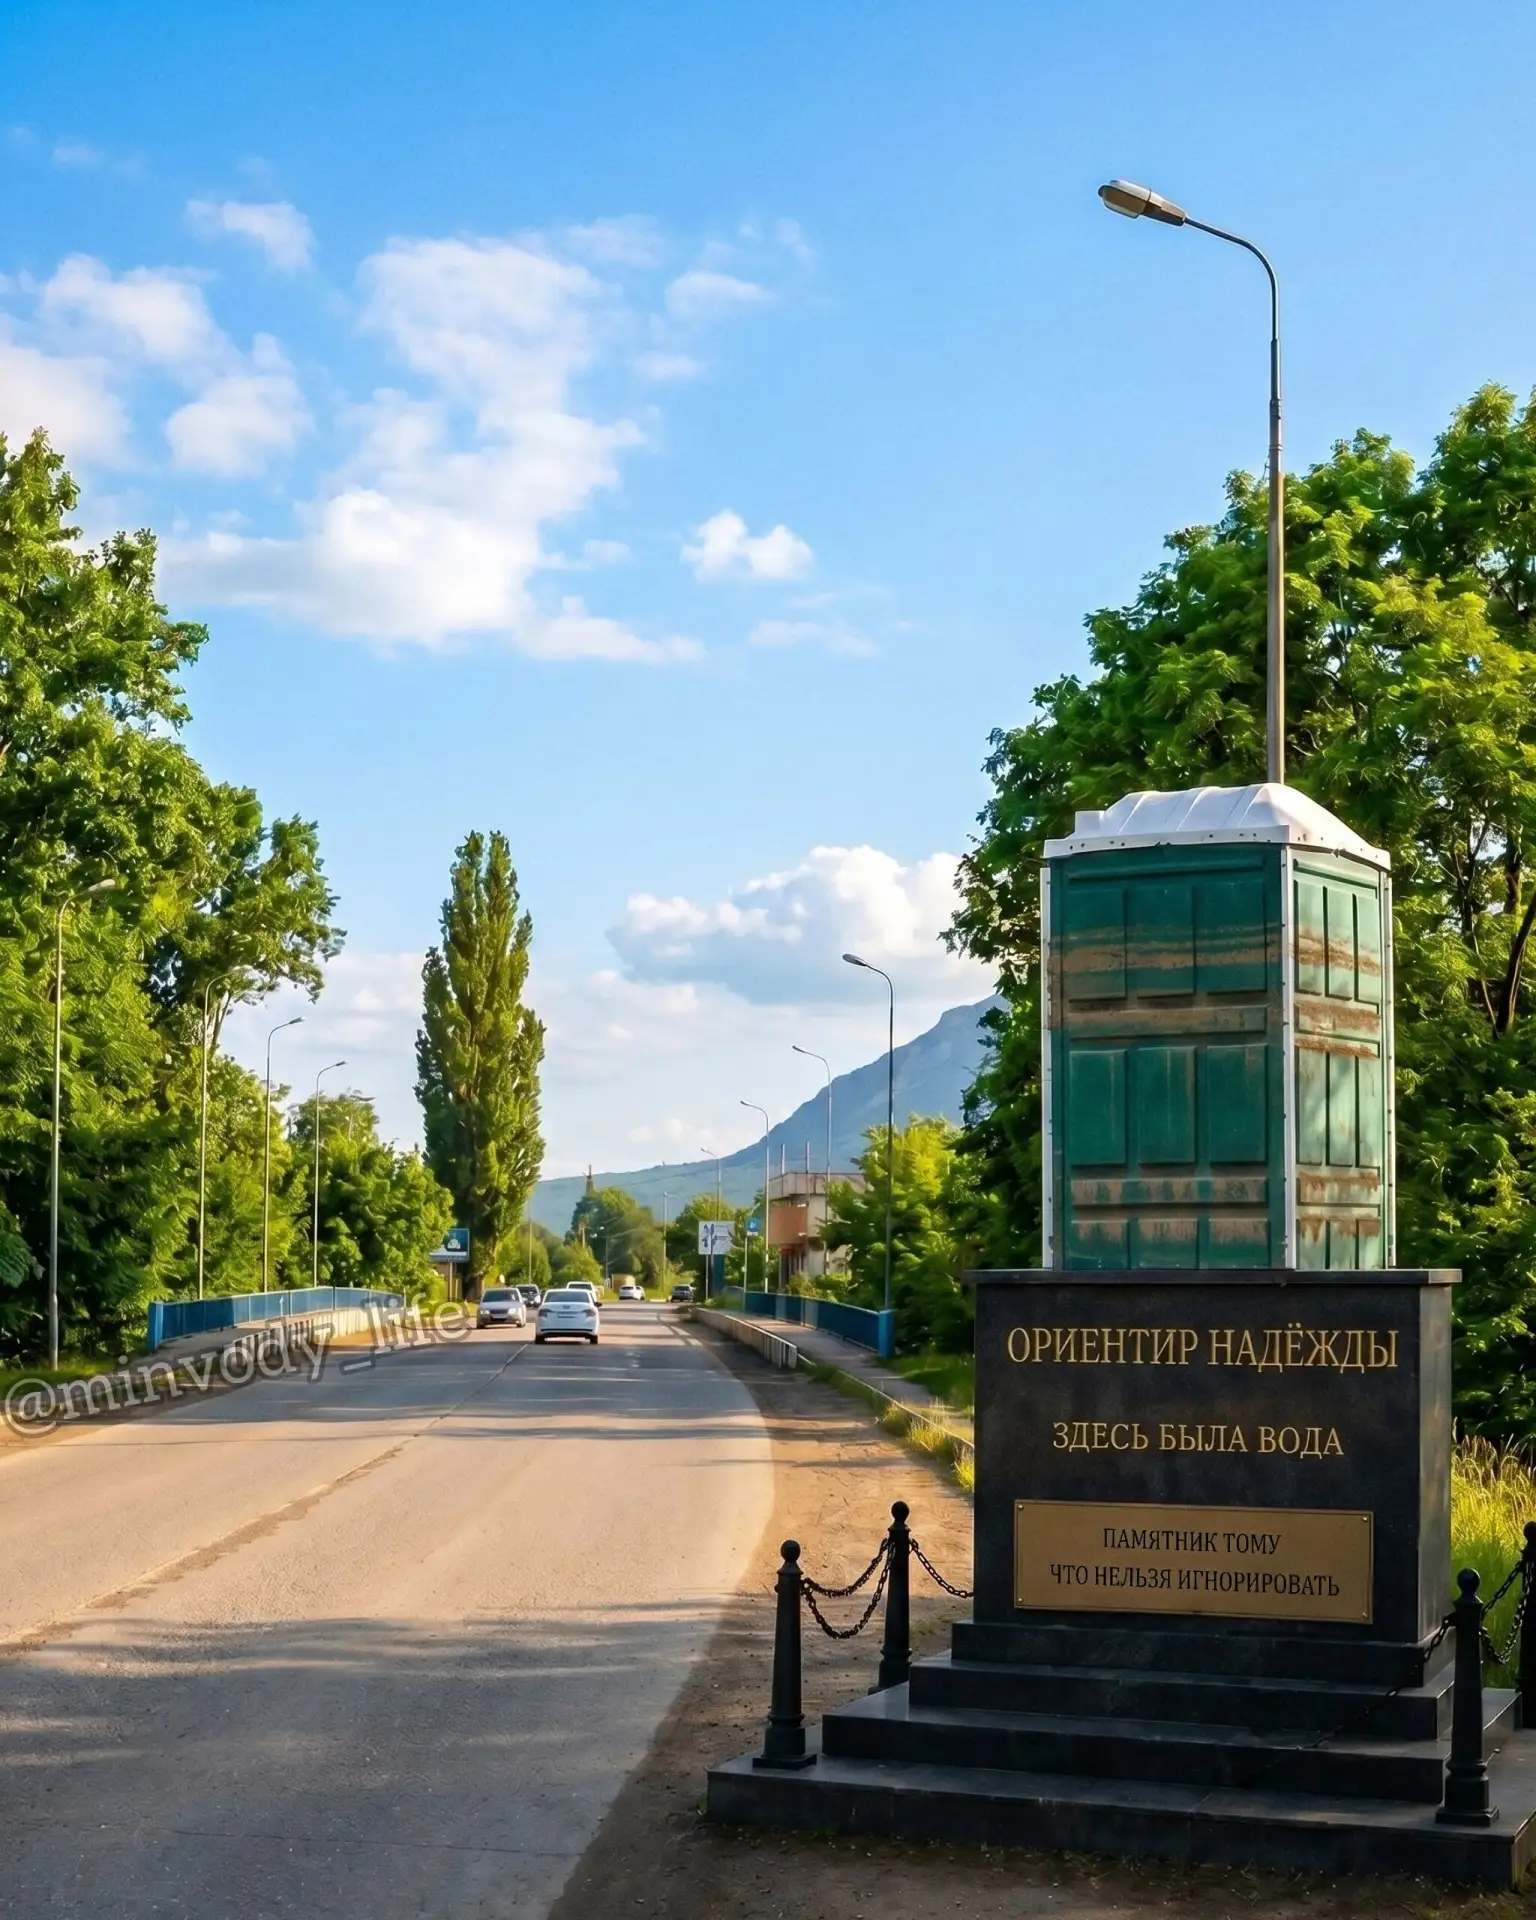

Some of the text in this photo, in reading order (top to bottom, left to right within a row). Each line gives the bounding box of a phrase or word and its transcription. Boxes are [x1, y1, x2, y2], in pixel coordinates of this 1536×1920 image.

[1007, 1322, 1399, 1374] ОРИЕНТИР НАДЁЖДЫ
[1053, 1421, 1345, 1459] ЗДЕСЬ БЫЛА ВОДА
[1102, 1527, 1282, 1555] ПАМЯТНИК ТОМУ
[1049, 1563, 1341, 1597] ЧТО НЕЛЬЗЯ ИГНОРИРОВАТЬ
